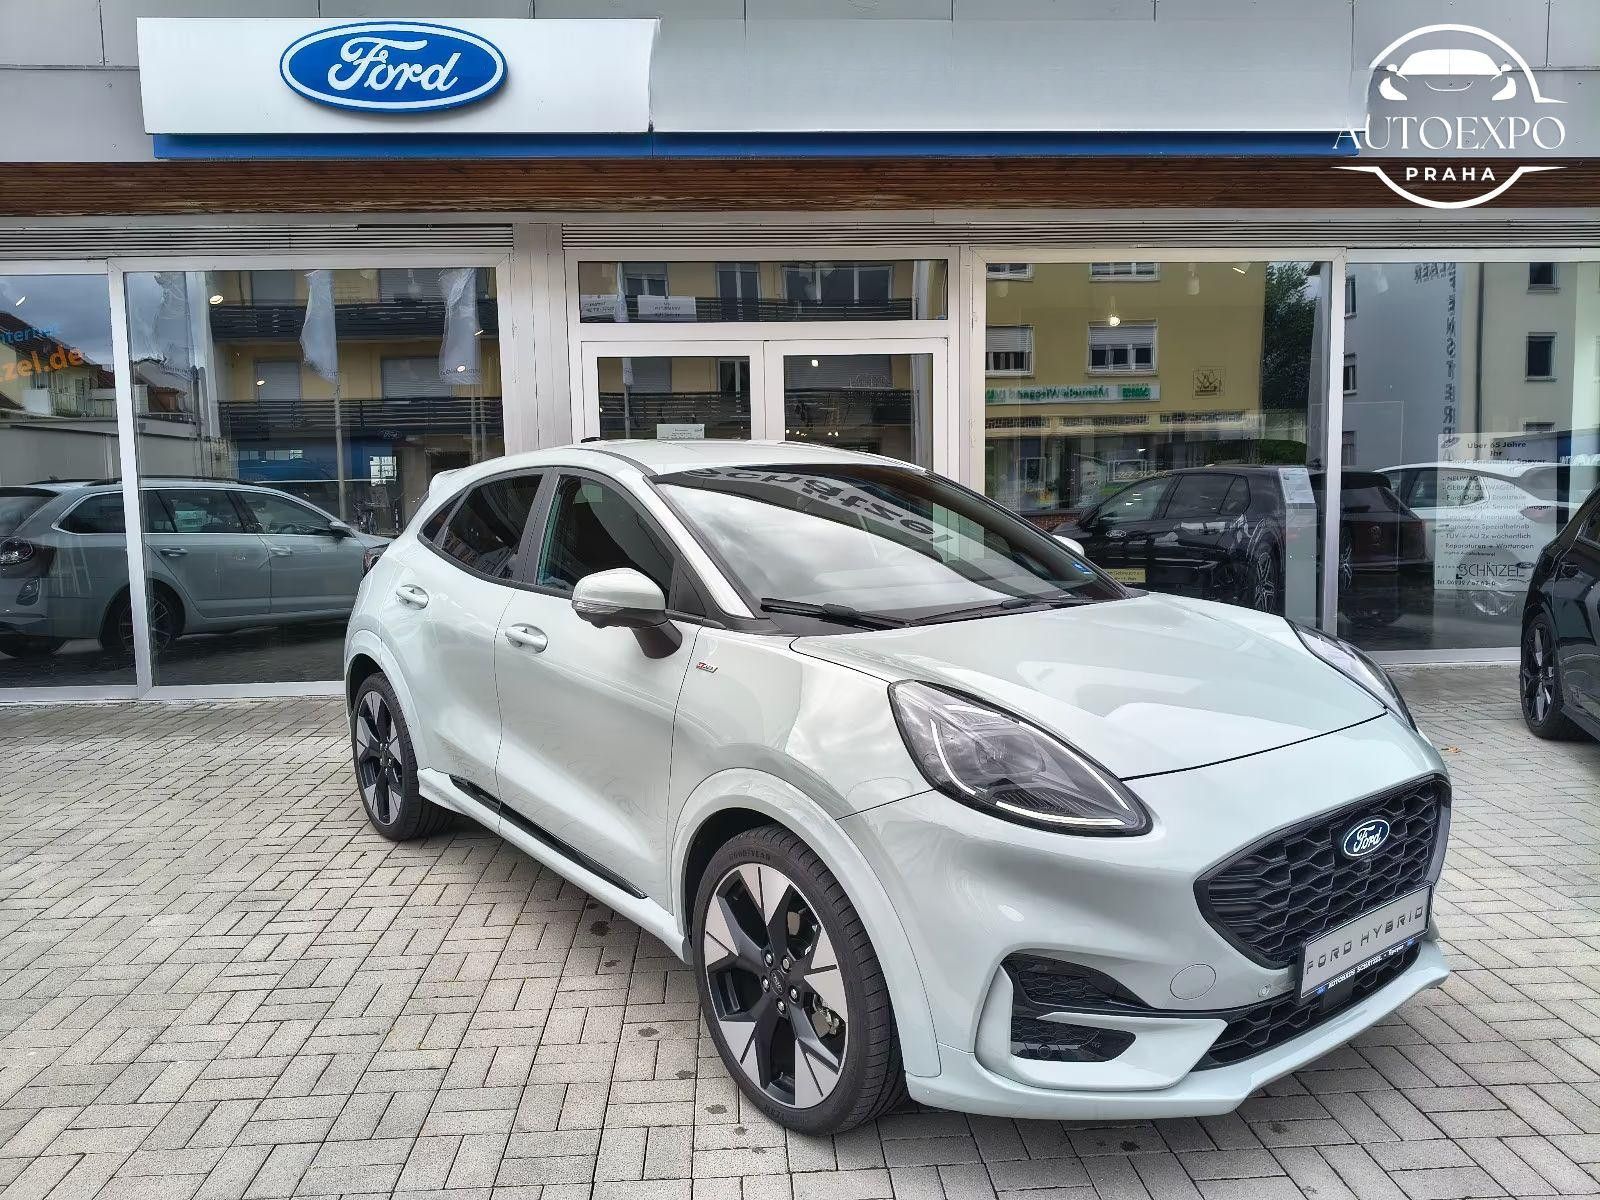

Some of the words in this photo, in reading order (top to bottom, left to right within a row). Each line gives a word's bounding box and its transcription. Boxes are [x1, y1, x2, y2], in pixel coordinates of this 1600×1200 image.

[327, 36, 462, 91] Ford
[1502, 440, 1527, 448] Jahre
[1353, 825, 1384, 853] Ford
[1307, 941, 1353, 975] FORD
[1360, 905, 1424, 947] HYBRID
